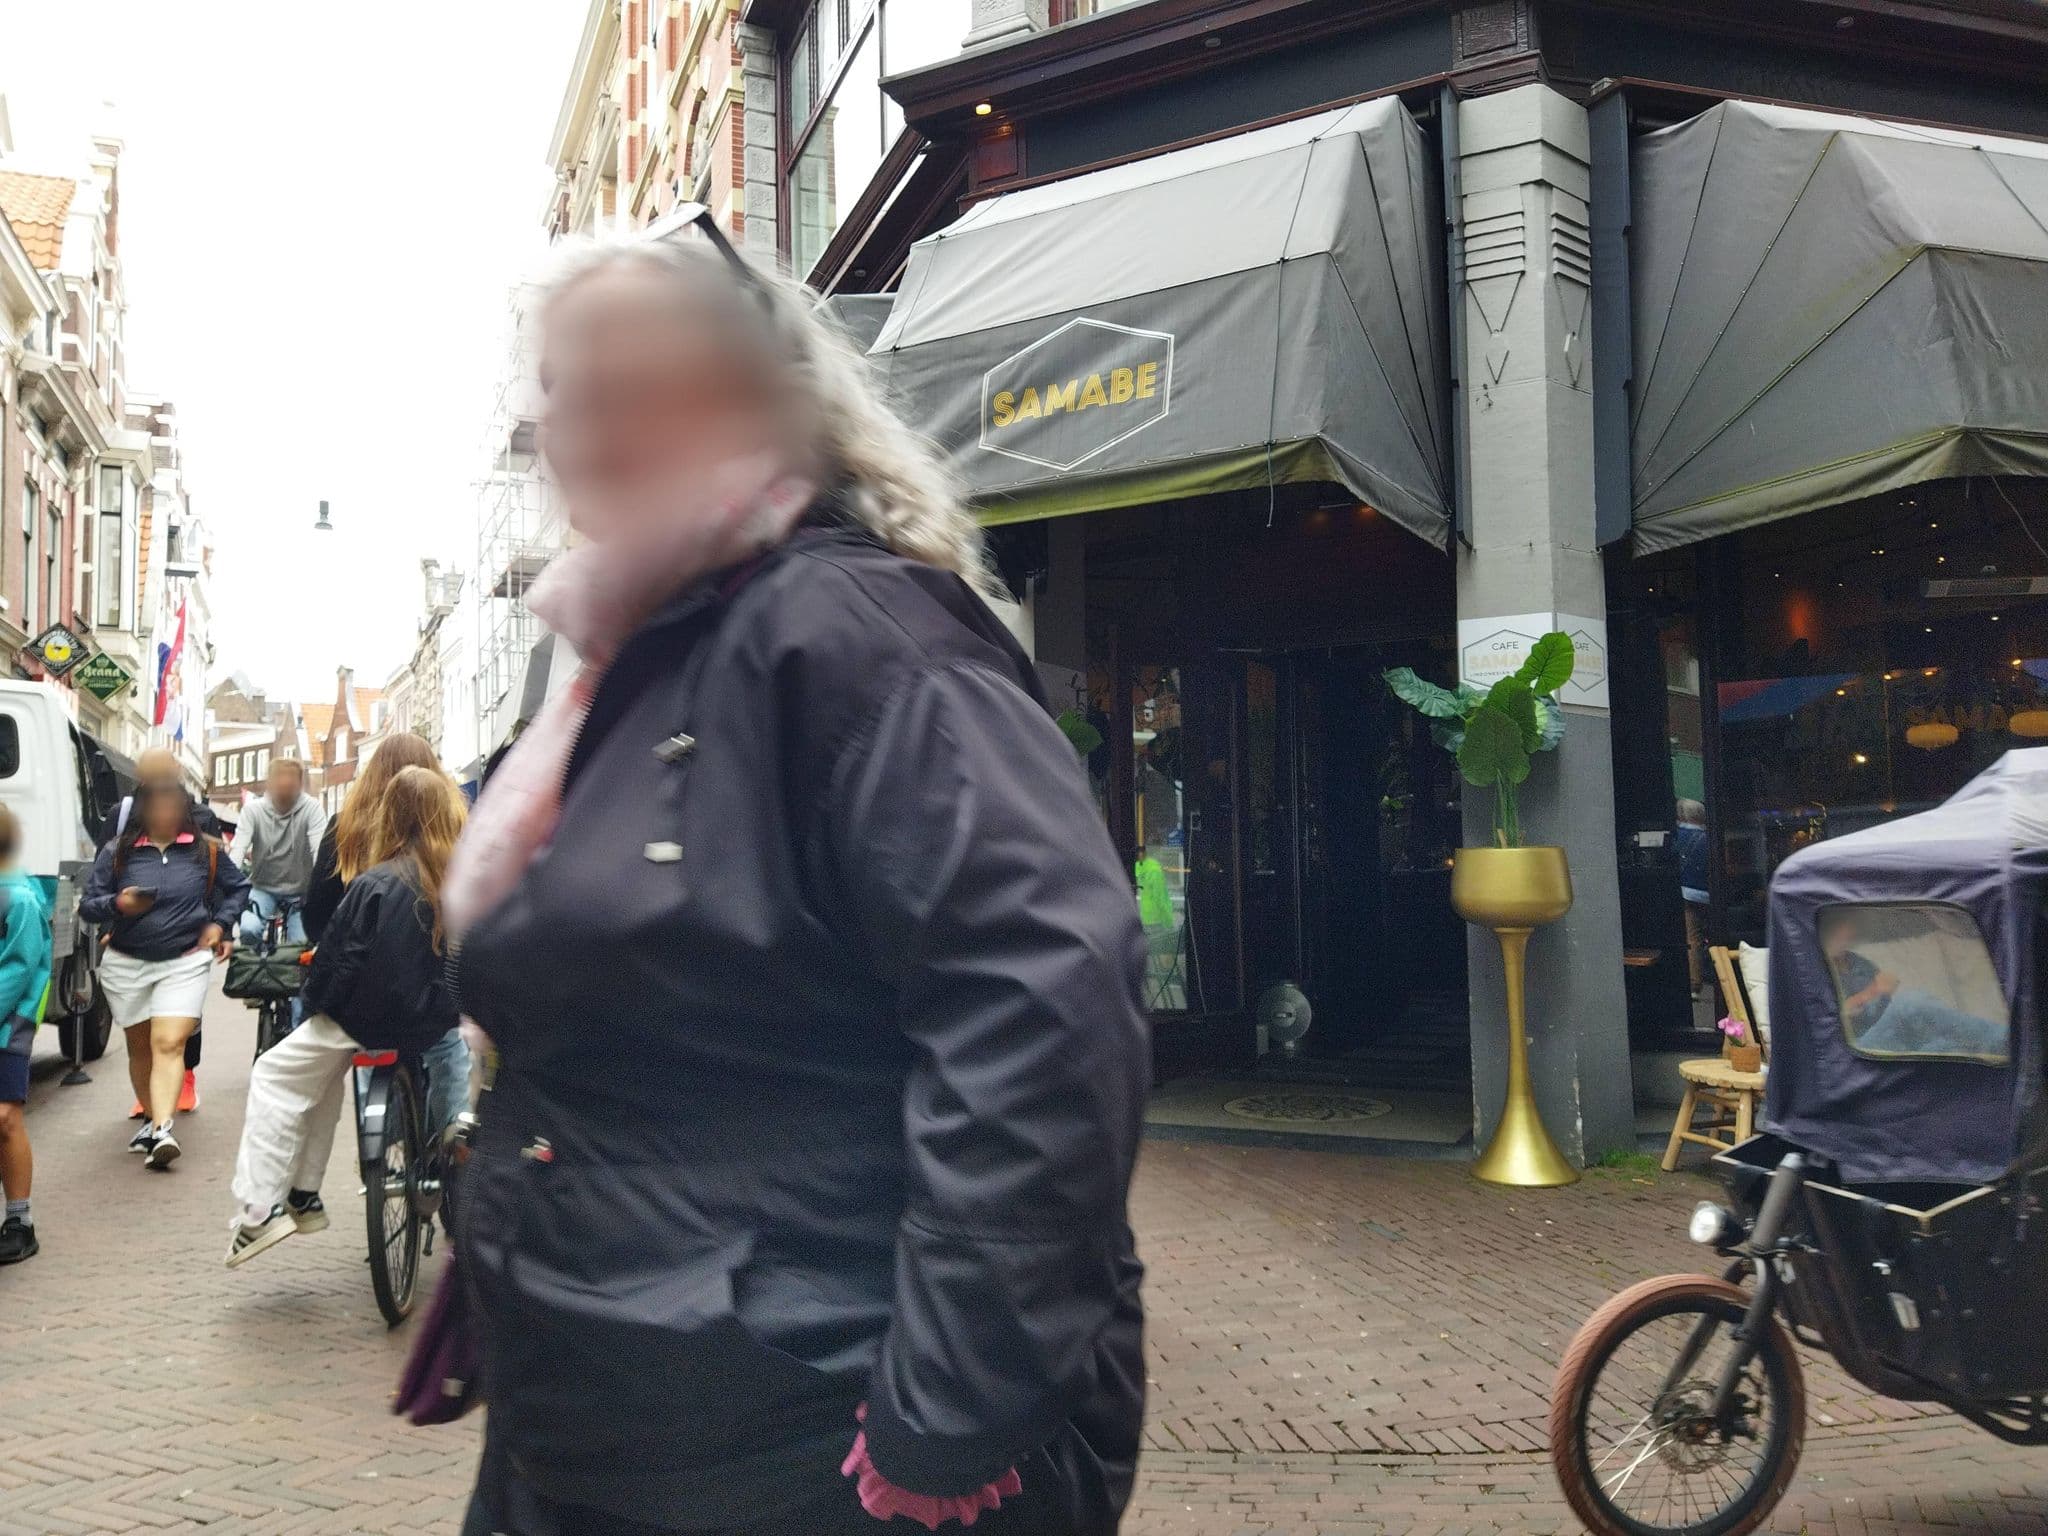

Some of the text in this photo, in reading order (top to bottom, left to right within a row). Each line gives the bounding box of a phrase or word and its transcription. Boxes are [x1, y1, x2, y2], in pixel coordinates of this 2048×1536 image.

[992, 361, 1158, 428] SAMABE
[1491, 641, 1519, 651] CAFE
[1469, 652, 1526, 671] SAMA
[84, 663, 120, 677] Brand
